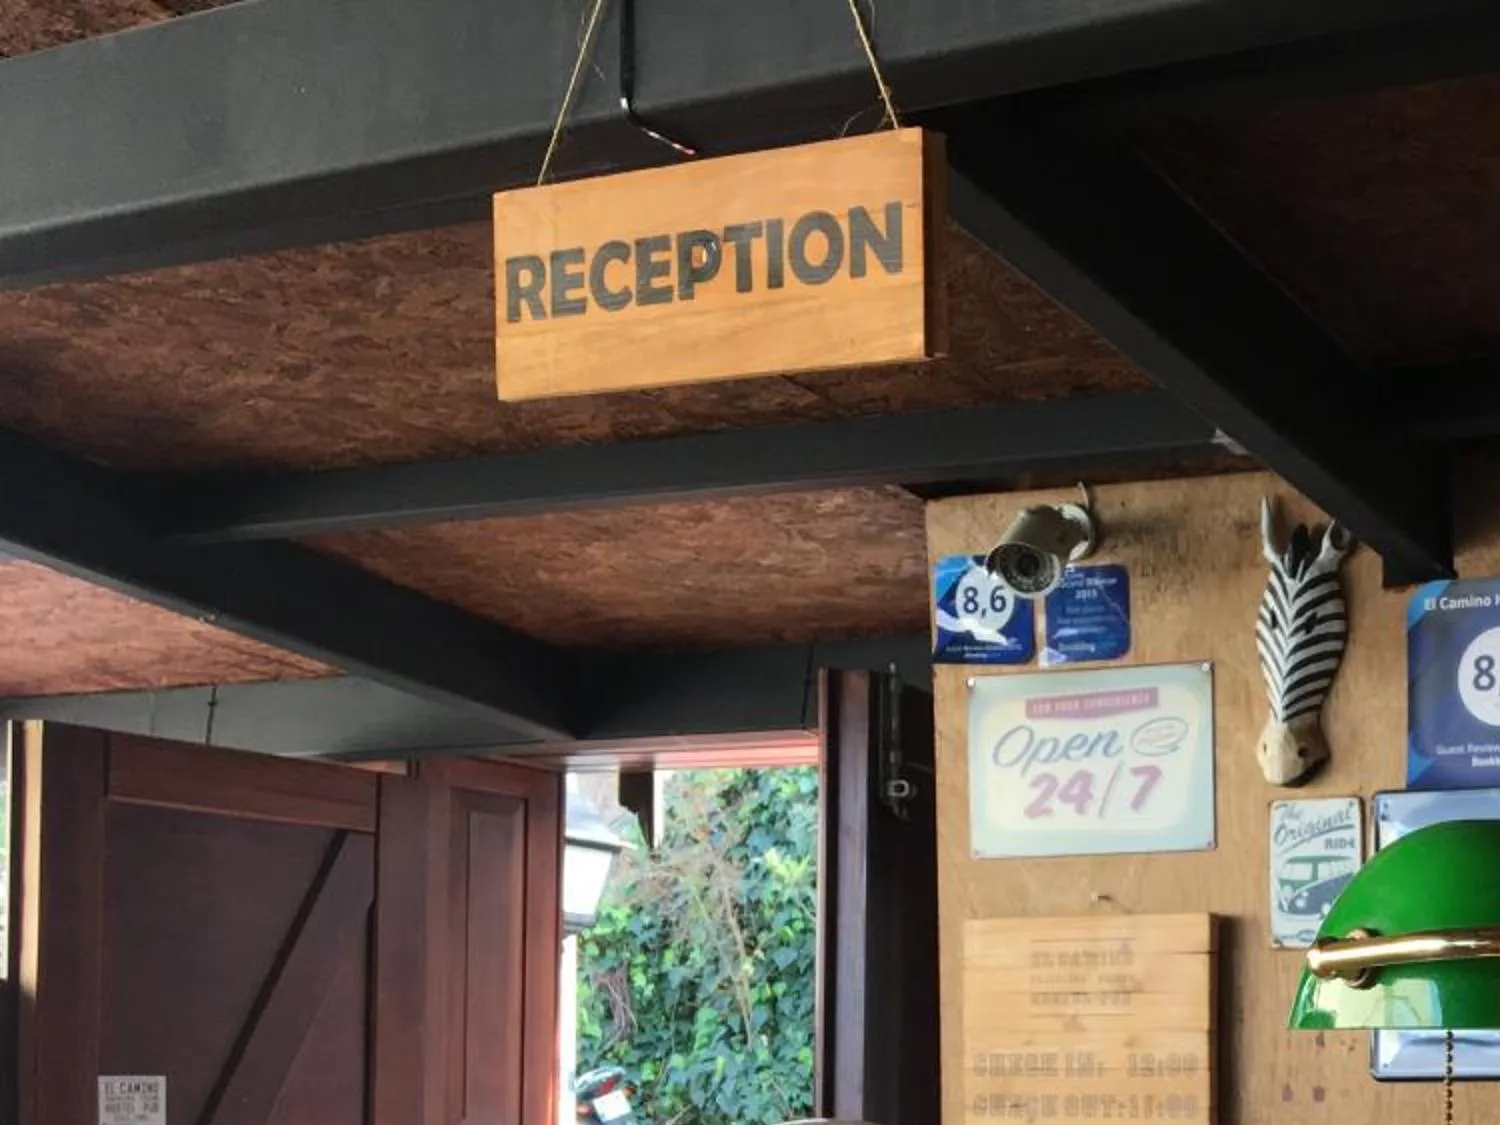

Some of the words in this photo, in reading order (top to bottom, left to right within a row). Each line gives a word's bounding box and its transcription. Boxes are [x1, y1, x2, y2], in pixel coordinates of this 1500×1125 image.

[506, 202, 904, 323] RECEPTION
[963, 586, 1007, 617] 8,6
[1440, 595, 1492, 611] Camino
[992, 724, 1125, 777] Open
[1024, 760, 1163, 819] 24/7
